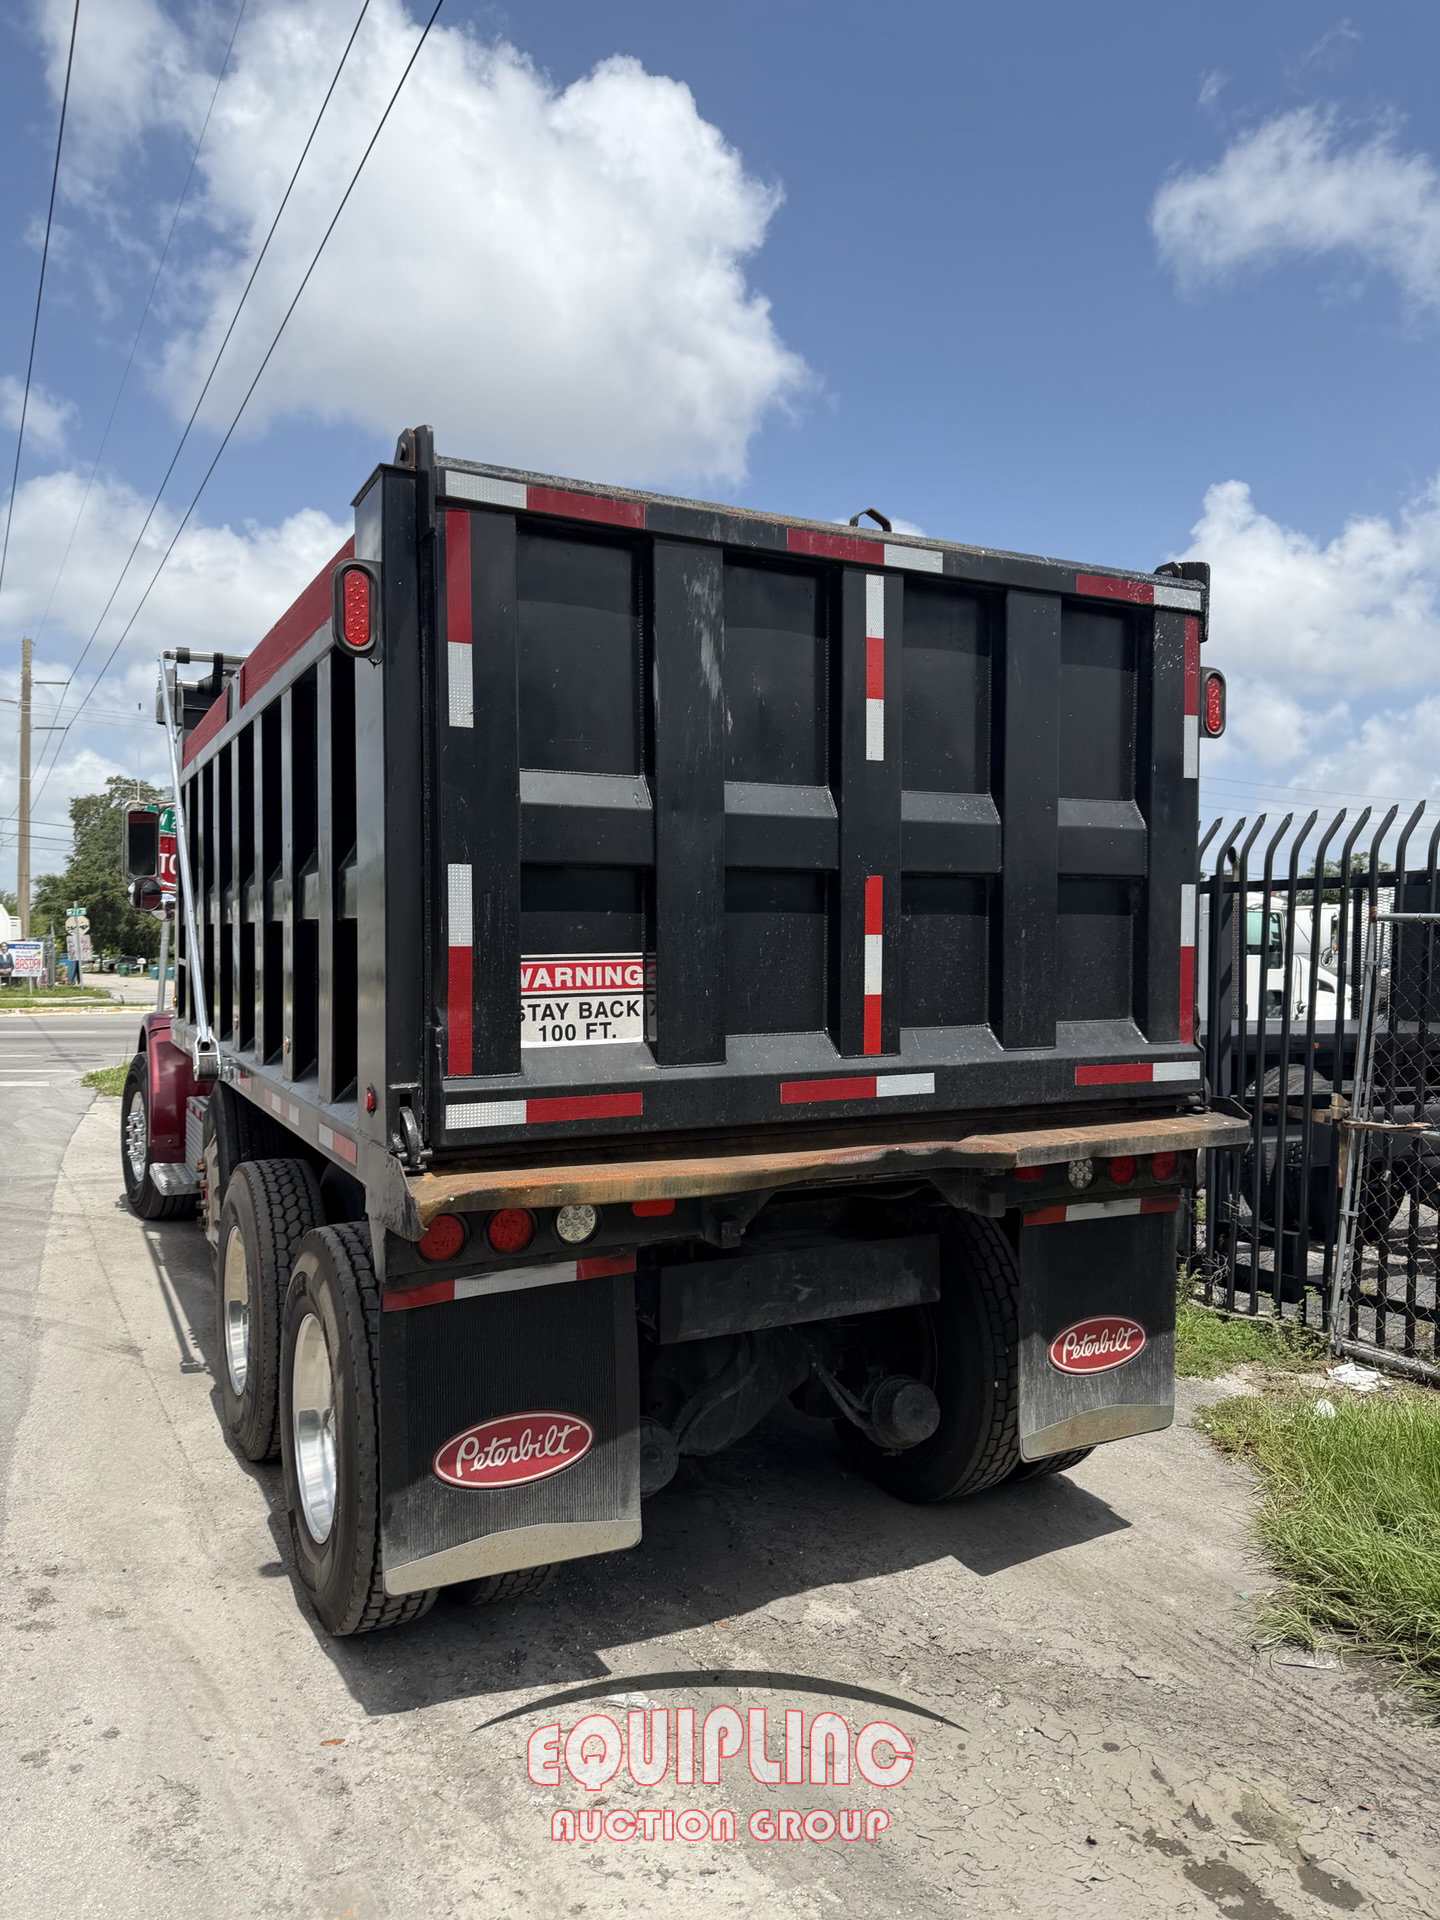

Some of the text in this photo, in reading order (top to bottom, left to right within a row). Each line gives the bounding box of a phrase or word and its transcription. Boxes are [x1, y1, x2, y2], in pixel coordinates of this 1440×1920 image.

[159, 853, 176, 874] TO
[579, 1000, 641, 1020] BACK
[538, 1022, 617, 1042] 100 FT.
[1063, 1327, 1138, 1364] Peterbilt
[456, 1424, 581, 1478] Peterbilt
